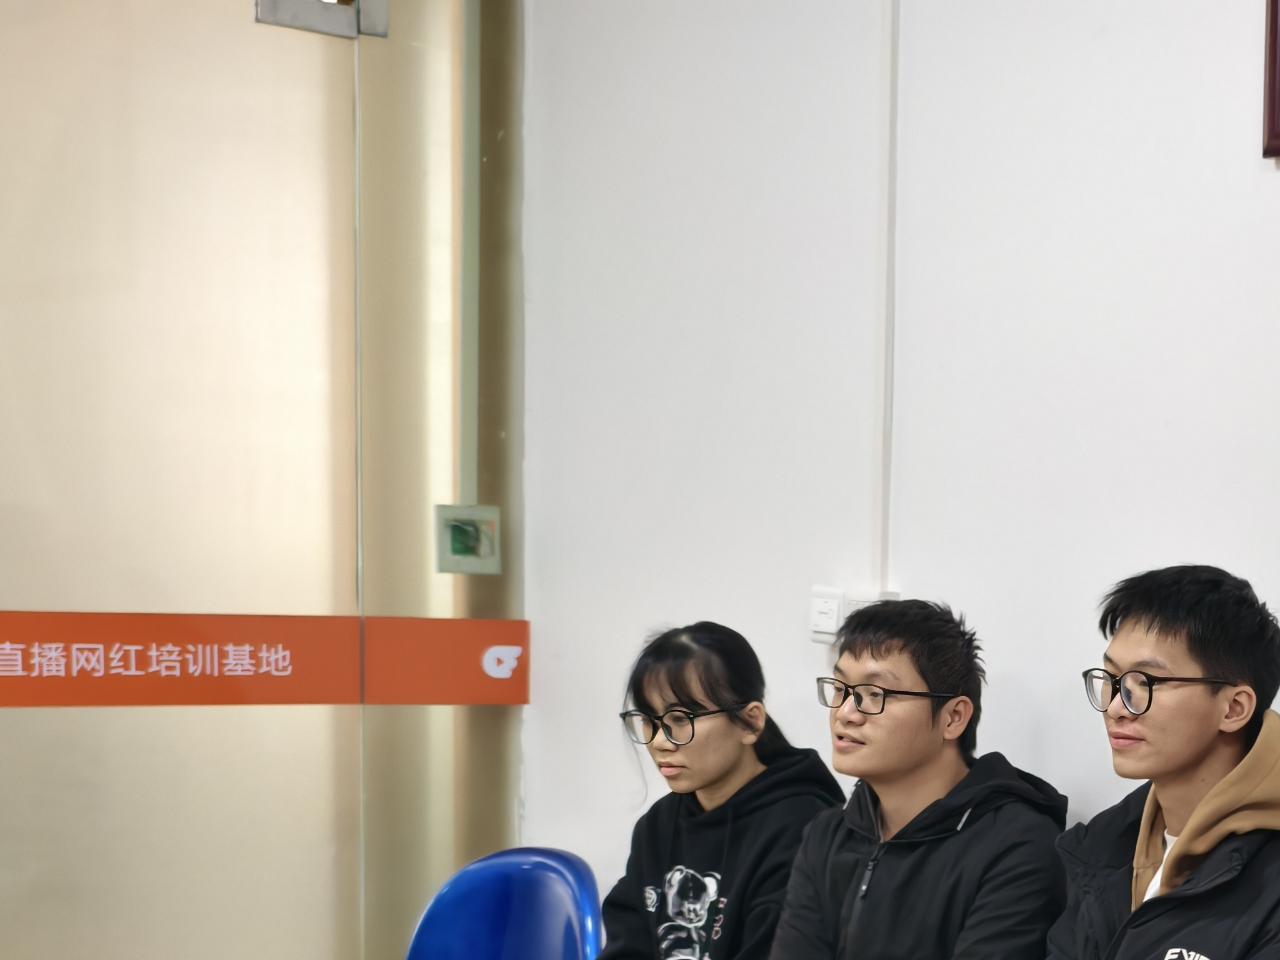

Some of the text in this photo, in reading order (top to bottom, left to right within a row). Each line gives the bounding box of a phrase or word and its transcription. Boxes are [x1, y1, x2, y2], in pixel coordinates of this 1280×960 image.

[0, 642, 293, 677] 直播网红培训基地
